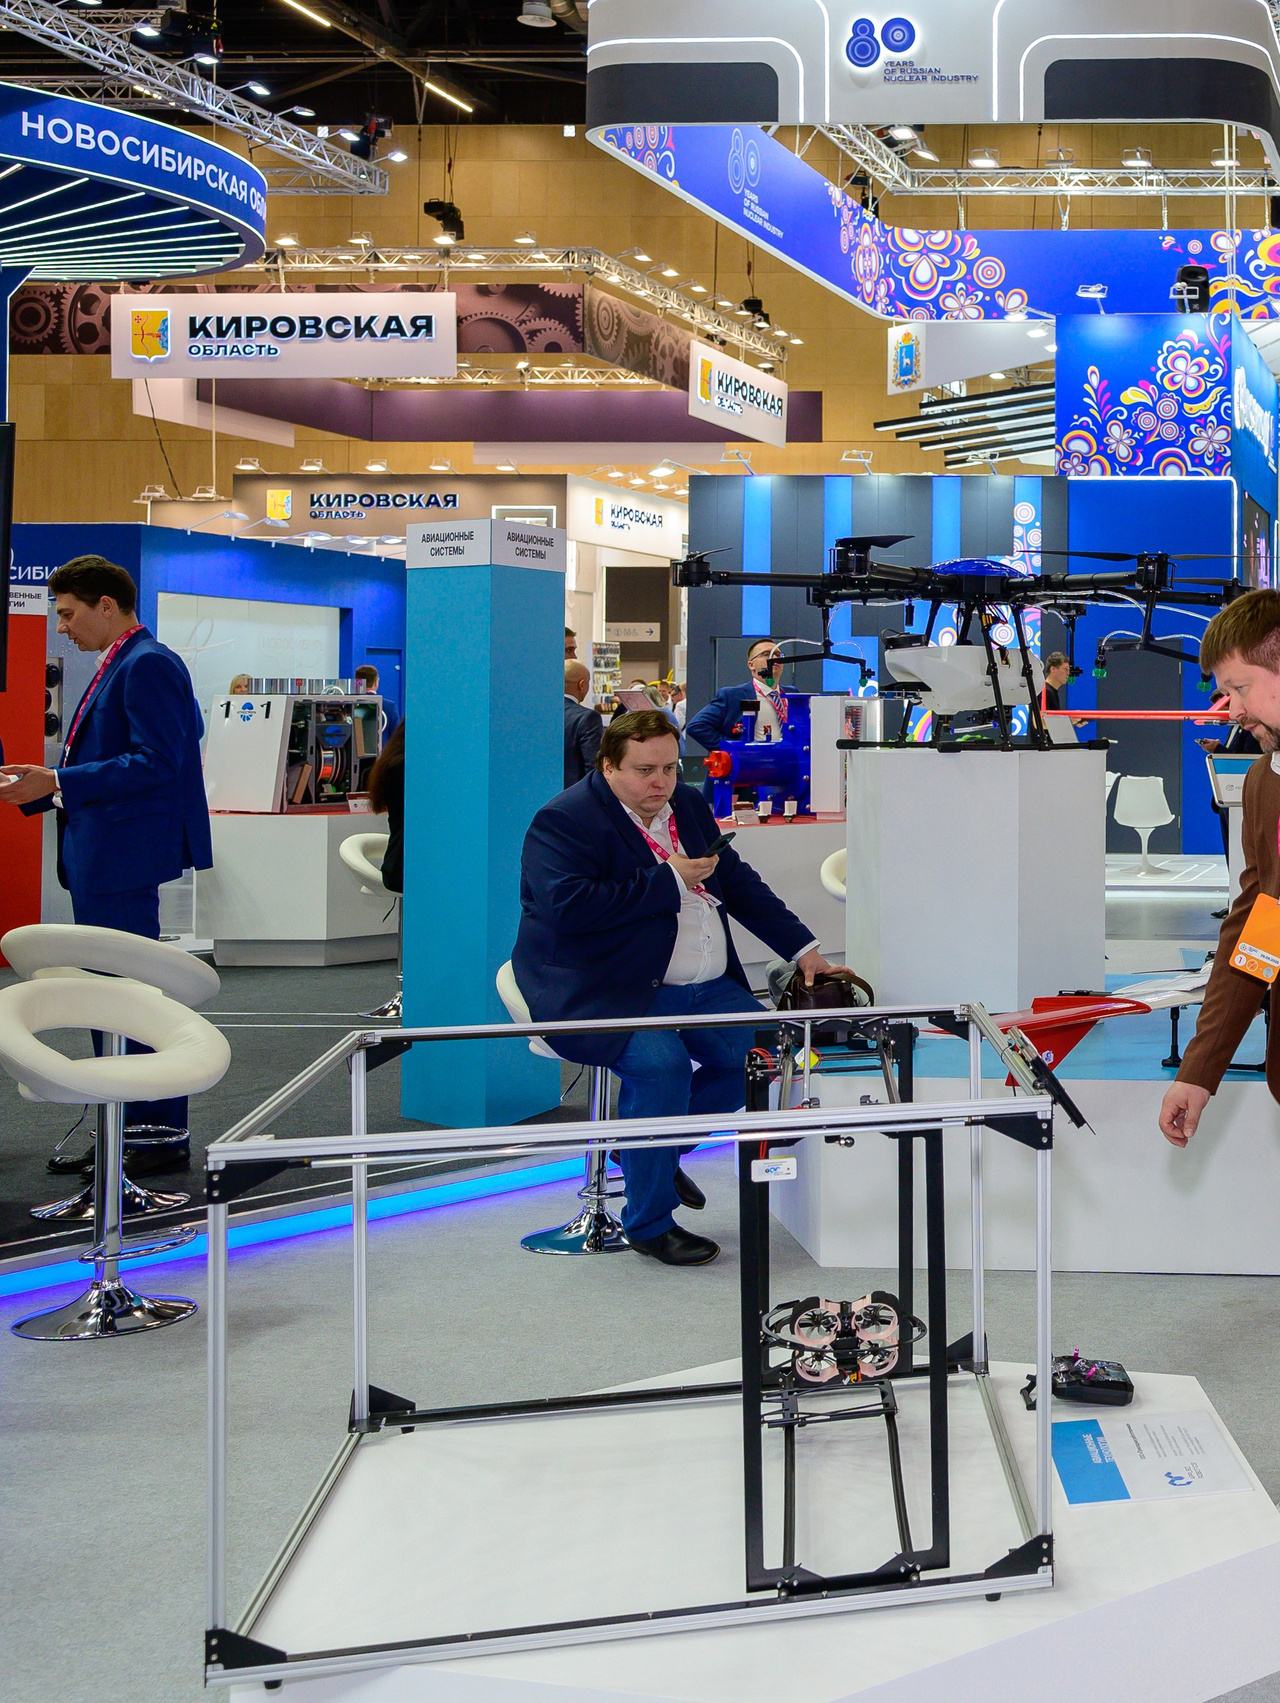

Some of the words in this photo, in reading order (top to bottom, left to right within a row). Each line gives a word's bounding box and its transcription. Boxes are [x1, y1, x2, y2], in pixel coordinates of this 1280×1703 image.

[931, 74, 979, 82] INDUSTRY
[21, 110, 248, 204] НОВОСИБИРСКАЯ
[188, 314, 435, 340] КИРОВСКАЯ
[188, 344, 280, 357] ОБЛАСТЬ
[716, 370, 783, 417] КИРОВСКАЯ
[309, 493, 459, 509] КИРОВСКАЯ
[309, 510, 366, 519] ОБЛАСТЬ
[610, 503, 663, 528] КИРОВСКАЯ
[421, 530, 475, 544] АВИАЦИОННЫЕ
[506, 531, 554, 548] АВИАЦИОННЫЕ
[429, 545, 465, 557] СИСТЕМЫ
[514, 546, 547, 560] СИСТЕМЫ
